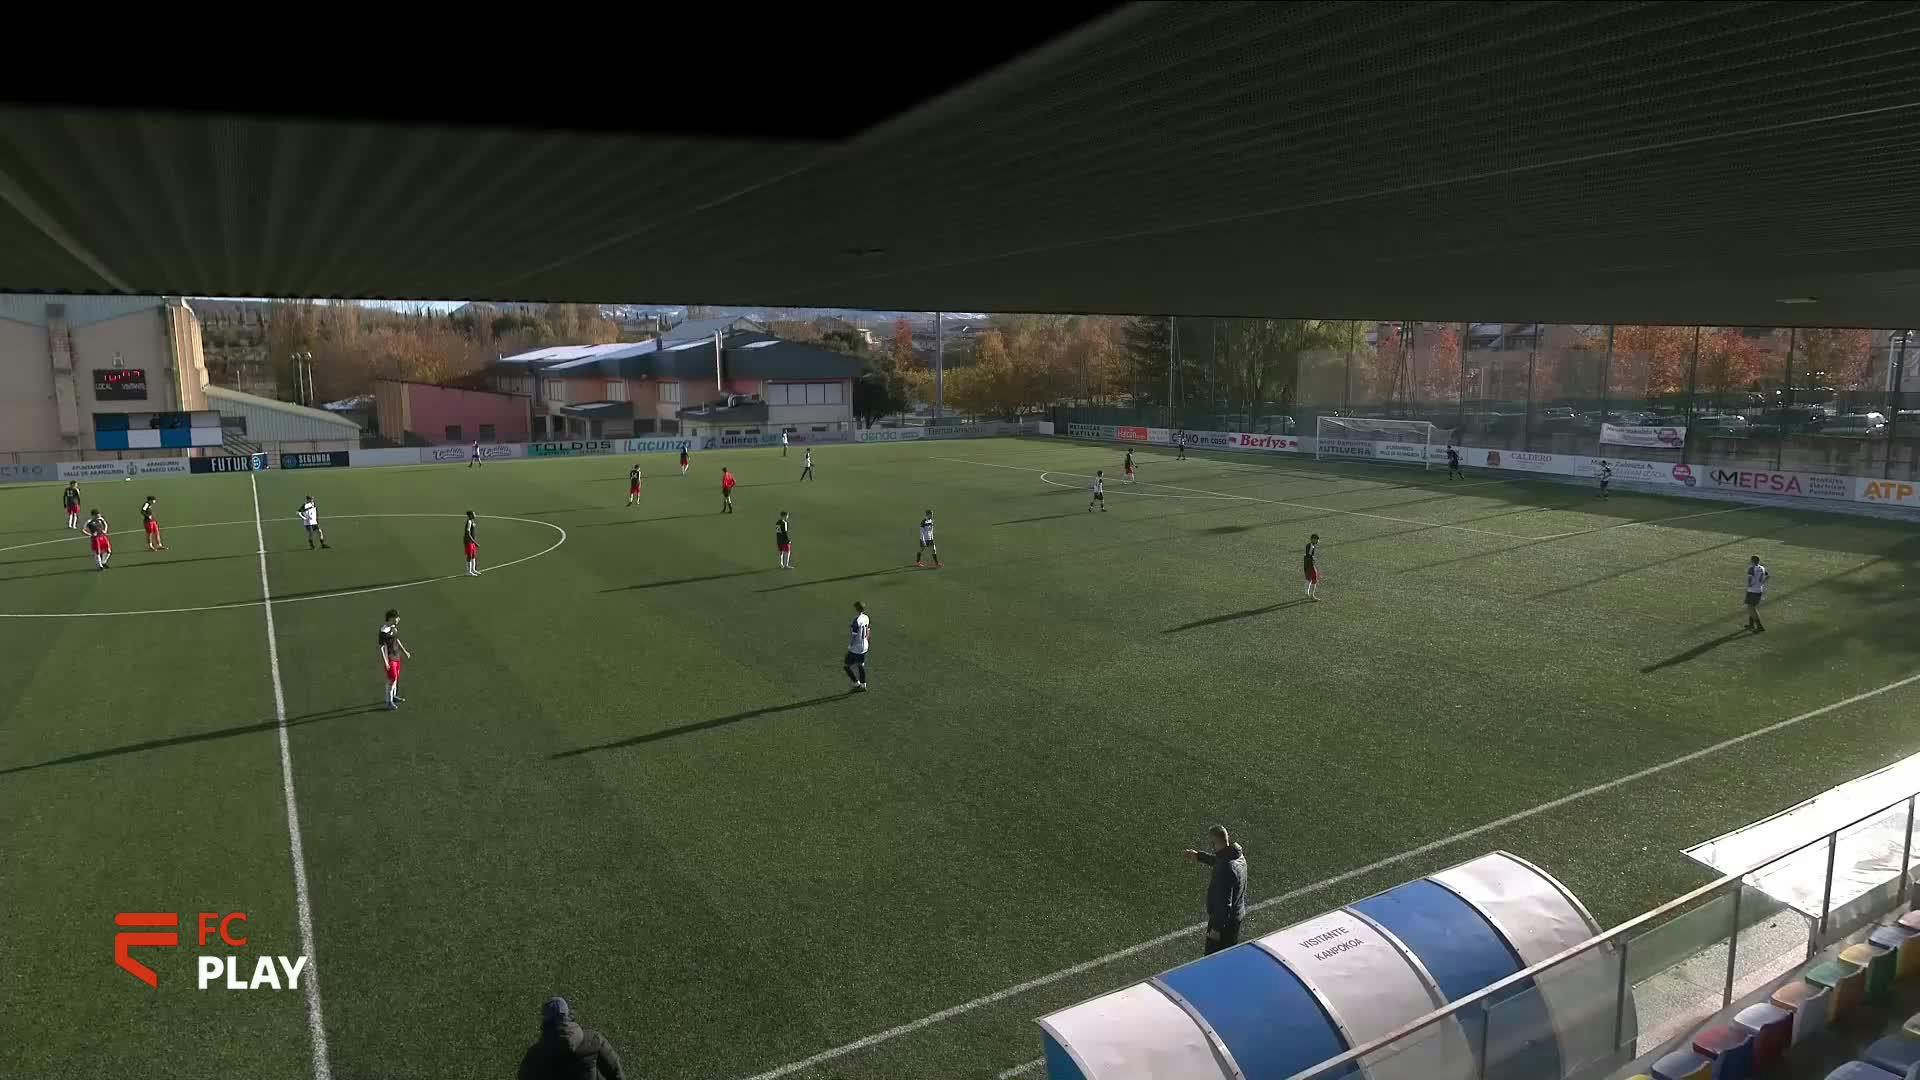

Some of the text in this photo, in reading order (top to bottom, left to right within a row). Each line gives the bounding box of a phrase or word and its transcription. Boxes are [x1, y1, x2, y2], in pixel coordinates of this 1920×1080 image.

[720, 435, 758, 446] talleres
[1239, 434, 1287, 449] Berlys
[1511, 452, 1552, 463] CALDERO
[1718, 469, 1802, 494] MEPSA
[1864, 481, 1913, 500] ATP
[1299, 926, 1349, 949] VISITANTE
[1314, 938, 1365, 961] KANPOKOA
